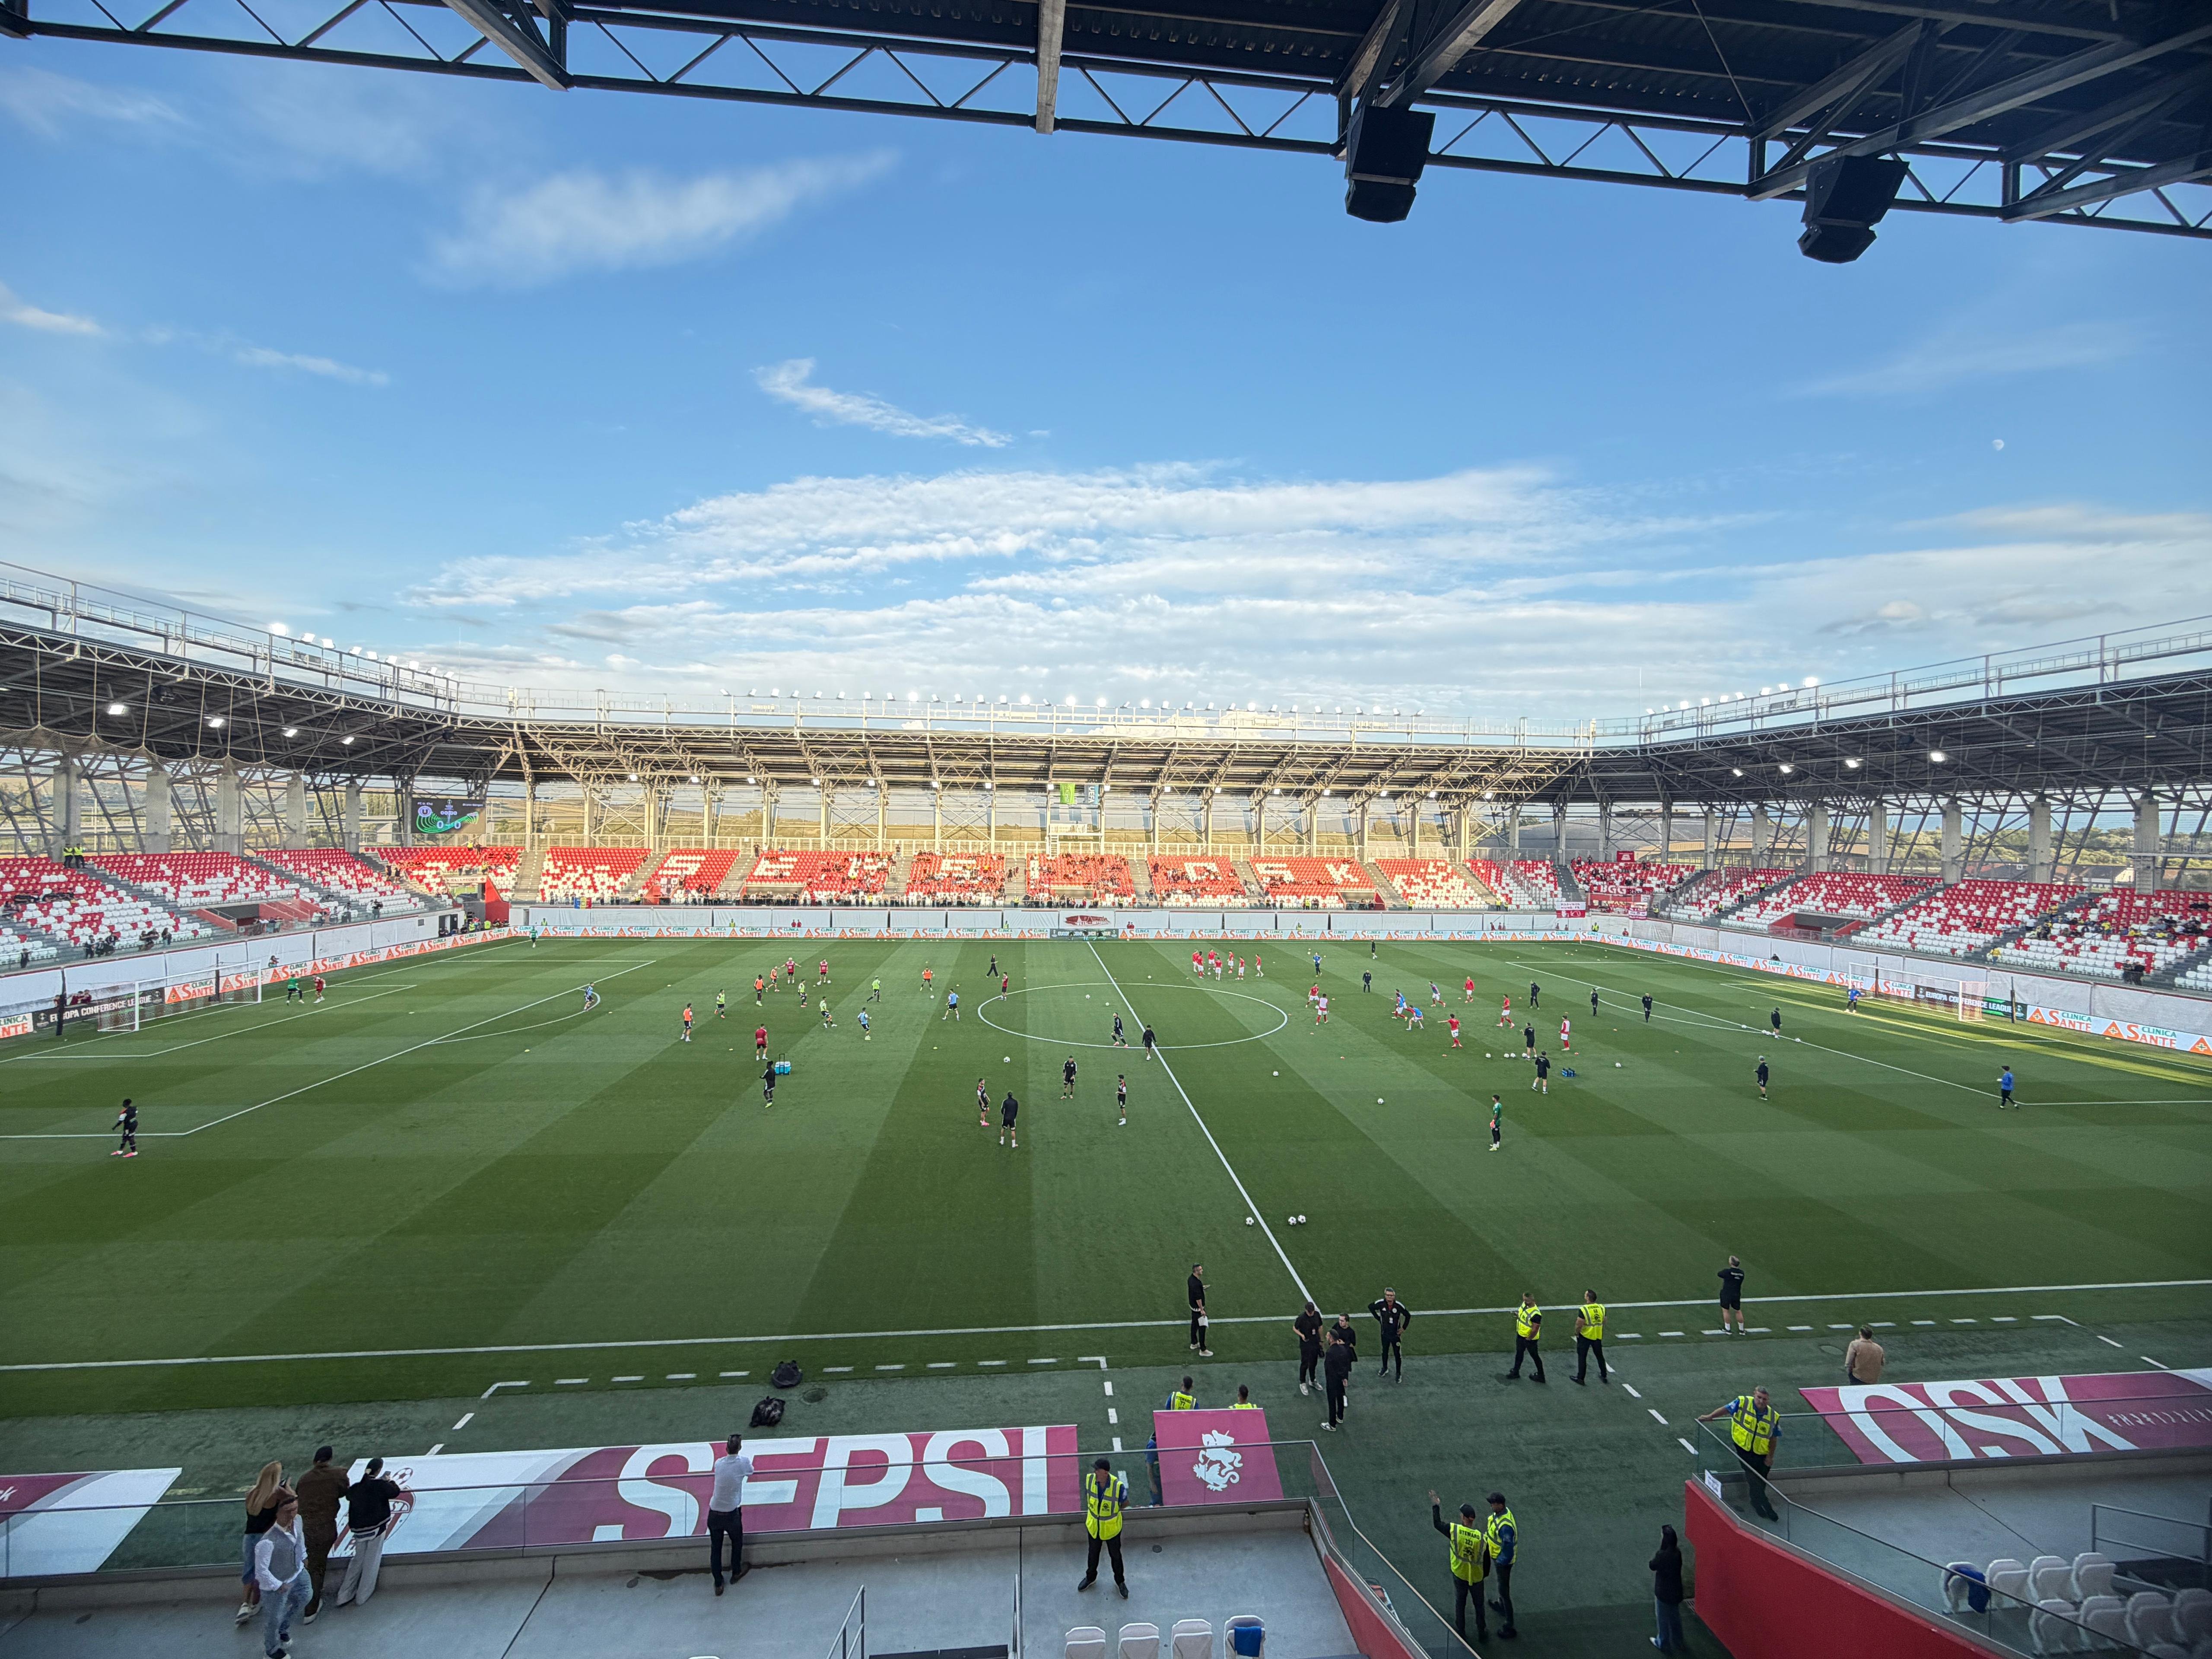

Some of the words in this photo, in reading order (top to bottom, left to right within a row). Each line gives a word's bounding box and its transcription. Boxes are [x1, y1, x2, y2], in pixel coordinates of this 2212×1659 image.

[488, 932, 505, 941] SANTE
[552, 927, 574, 936] SANTE
[591, 927, 613, 936] SANTE
[627, 927, 649, 936] SANTE
[666, 927, 688, 937] SANTE
[704, 927, 726, 937] SANTE
[739, 928, 760, 937] SANTE
[777, 928, 798, 937] SANTE
[814, 928, 836, 937] SANTE
[849, 928, 870, 938] SANTE
[886, 928, 906, 938] SANTE
[922, 928, 943, 938] SANTE
[956, 929, 976, 938] SANTE
[992, 929, 1012, 938] SANTE
[1027, 929, 1048, 938] SANTE
[1129, 929, 1149, 938] SANTE
[1164, 929, 1184, 938] SANTE
[1198, 929, 1218, 938] SANTE
[1230, 930, 1249, 939] SANTE
[1264, 930, 1283, 939] SANTE
[1297, 930, 1316, 939] SANTE
[1328, 930, 1347, 939] SANTE
[1361, 931, 1380, 940] SANTE
[1394, 931, 1413, 940] SANTE
[1424, 931, 1443, 940] SANTE
[1457, 931, 1475, 940] SANTE
[1489, 931, 1507, 940] SANTE
[1519, 931, 1537, 941] SANTE
[1551, 931, 1568, 941] SANTE
[1582, 932, 1598, 940] SANTE
[459, 935, 477, 945] SANTE
[1607, 935, 1623, 944] SANTE
[1635, 939, 1651, 949] SANTE
[427, 940, 446, 950] SANTE
[1664, 944, 1682, 954] SANTE
[395, 945, 415, 957] SANTE
[1694, 949, 1713, 961] SANTE
[359, 952, 380, 963] SANTE
[1727, 954, 1748, 967] SANTE
[321, 959, 343, 971] SANTE
[1762, 960, 1783, 972] SANTE
[1797, 966, 1819, 979] SANTE
[192, 980, 213, 988] CLINICA
[235, 974, 263, 989] SANT
[1892, 982, 1912, 990] CLINICA
[182, 983, 213, 999] SANTE
[1883, 981, 1912, 998] SANTE
[1926, 991, 1947, 1001] EUROPA
[50, 1009, 79, 1023] EOPA
[81, 1001, 126, 1016] CONFERENCE
[127, 995, 152, 1007] LEGUE
[0, 1015, 28, 1026] LINICA
[2049, 1011, 2091, 1033] SANTE
[2062, 1012, 2092, 1022] CLINICA
[2, 1023, 28, 1036] NTE
[2142, 1026, 2177, 1038] CLINICA
[2127, 1024, 2177, 1049] SANTE
[1838, 1376, 2142, 1462] OSK
[1459, 1529, 1480, 1540] STEWARD
